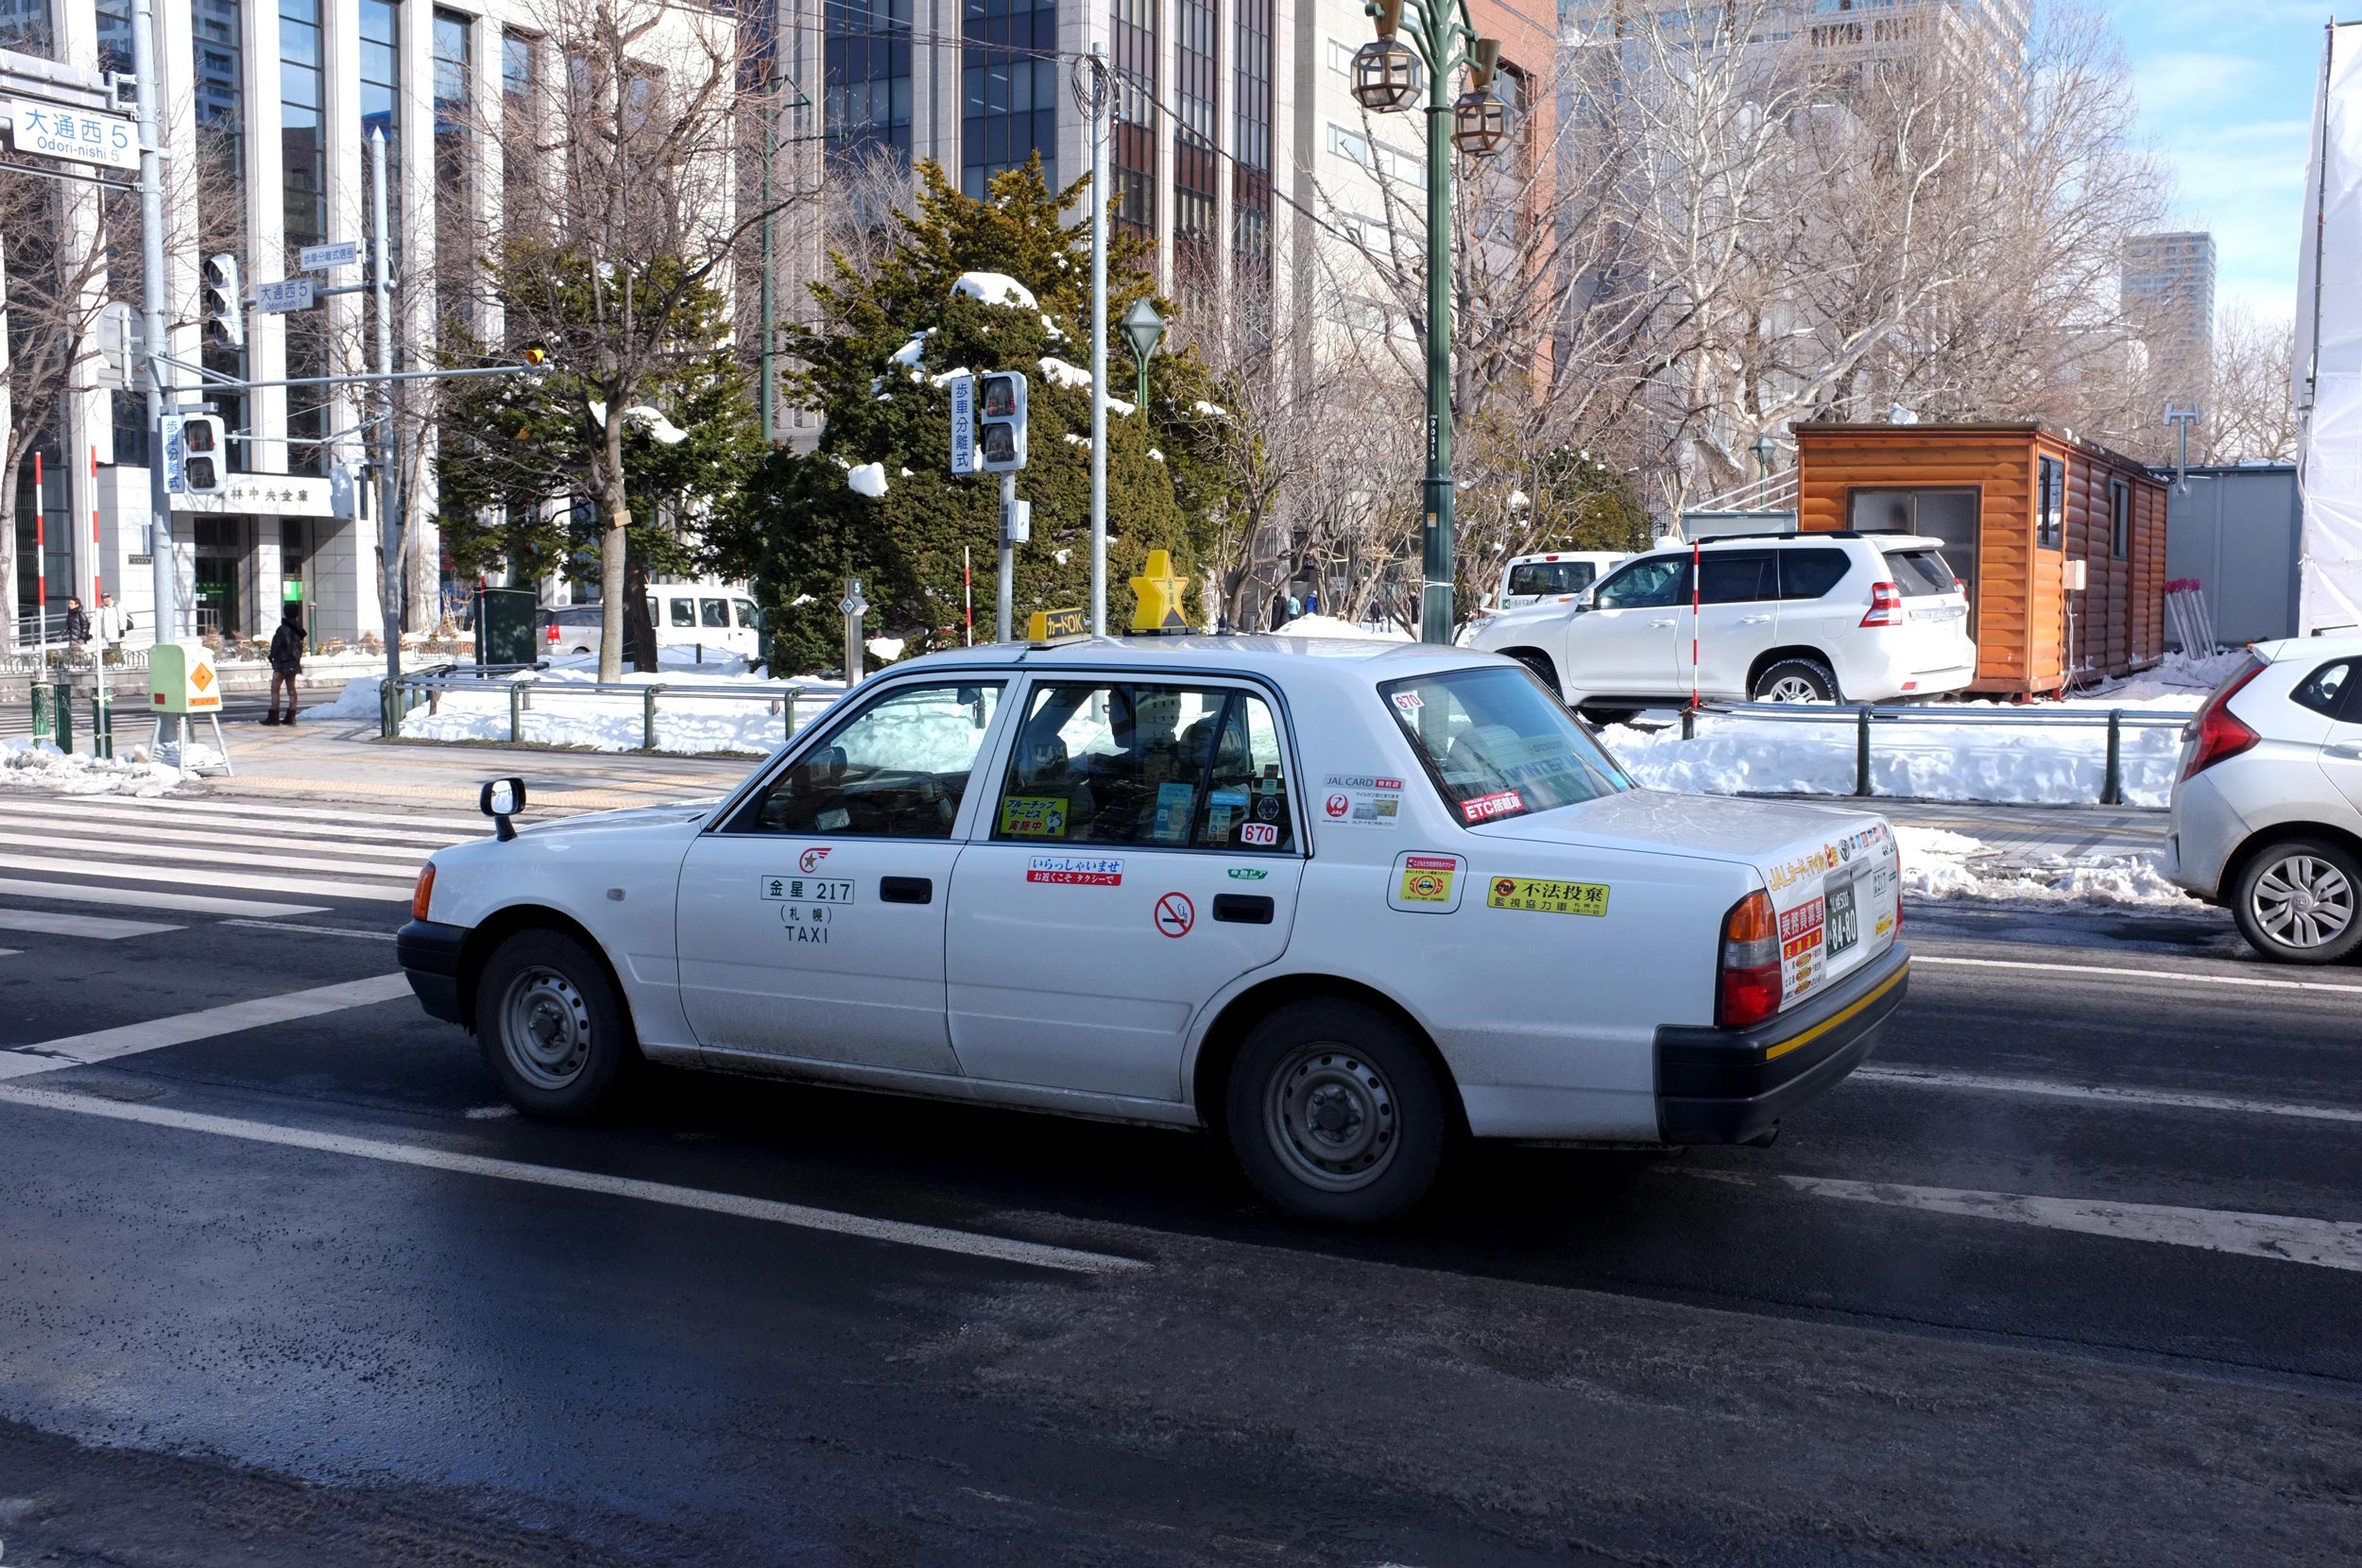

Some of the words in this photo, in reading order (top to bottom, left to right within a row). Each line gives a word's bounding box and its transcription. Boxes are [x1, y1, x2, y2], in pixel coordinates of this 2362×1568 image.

[37, 136, 107, 160] Odori-nishi
[111, 149, 120, 162] 5
[303, 247, 353, 264] 歩車分離式信号
[265, 298, 297, 311] Odori-nishi
[299, 298, 303, 307] 5
[955, 383, 969, 468] 歩車分離式
[166, 420, 180, 489] 歩車分離式
[854, 582, 861, 593] 5
[1047, 612, 1084, 637] カードOK
[1395, 694, 1421, 708] 670
[1326, 776, 1344, 785] JAL
[1345, 777, 1374, 787] CARD
[1006, 799, 1057, 810] ブルーチップ
[1010, 809, 1041, 819] サービス
[1007, 820, 1042, 831] 実施中
[1244, 825, 1275, 843] 670
[1033, 858, 1120, 873] いらっしゃいませ
[1034, 872, 1072, 883] お近くこそ
[1077, 874, 1114, 884] タクシーで
[770, 879, 803, 897] 金星
[816, 883, 850, 900] 217
[1521, 882, 1603, 902] 不法投棄
[1494, 896, 1567, 912] 監視協力車
[1782, 900, 1823, 939] 乗務員募集
[785, 926, 828, 944] TAXI
[1832, 909, 1857, 950] 84-80
